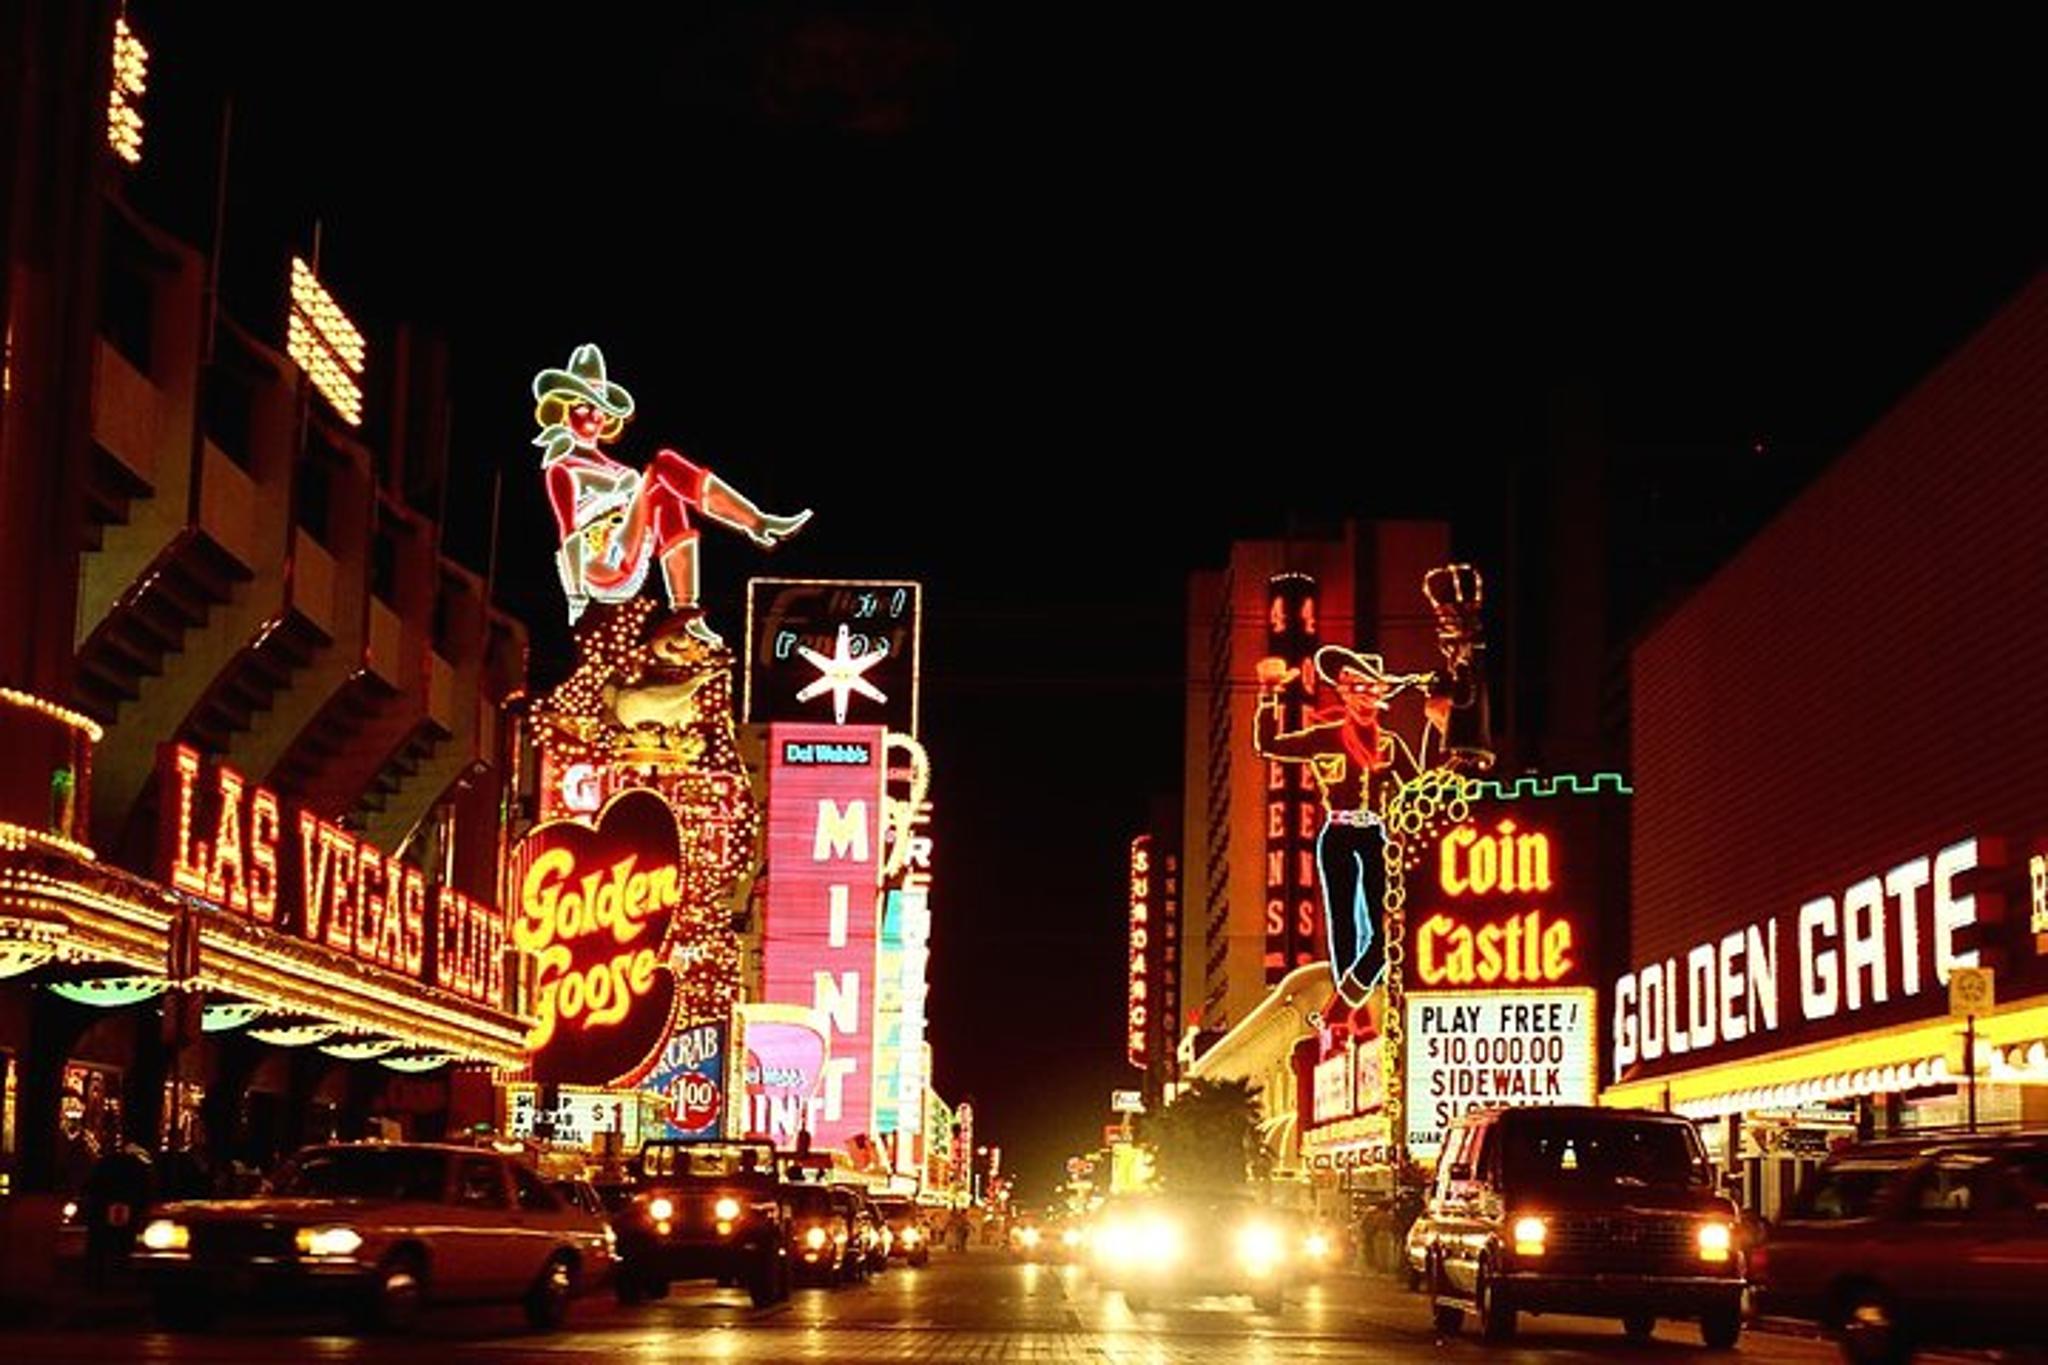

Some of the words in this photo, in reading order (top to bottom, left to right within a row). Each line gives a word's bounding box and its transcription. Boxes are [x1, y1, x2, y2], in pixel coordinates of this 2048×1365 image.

[172, 742, 279, 922] LAS
[300, 808, 425, 978] VEGAS
[436, 886, 504, 1012] CLUB
[1440, 819, 1552, 896] Coin
[513, 848, 682, 952] Golden
[813, 799, 870, 1122] MINT
[1417, 910, 1573, 985] Castle
[1614, 917, 1779, 1080] GOLDEN
[1799, 837, 1980, 1021] GATE
[524, 944, 655, 1053] Goose
[1421, 1005, 1481, 1033] PLAY
[1500, 1003, 1577, 1032] FREE!
[667, 1026, 718, 1067] CRAB
[1428, 1037, 1563, 1066] $10,000.00
[1430, 1069, 1562, 1096] SIDEWALK
